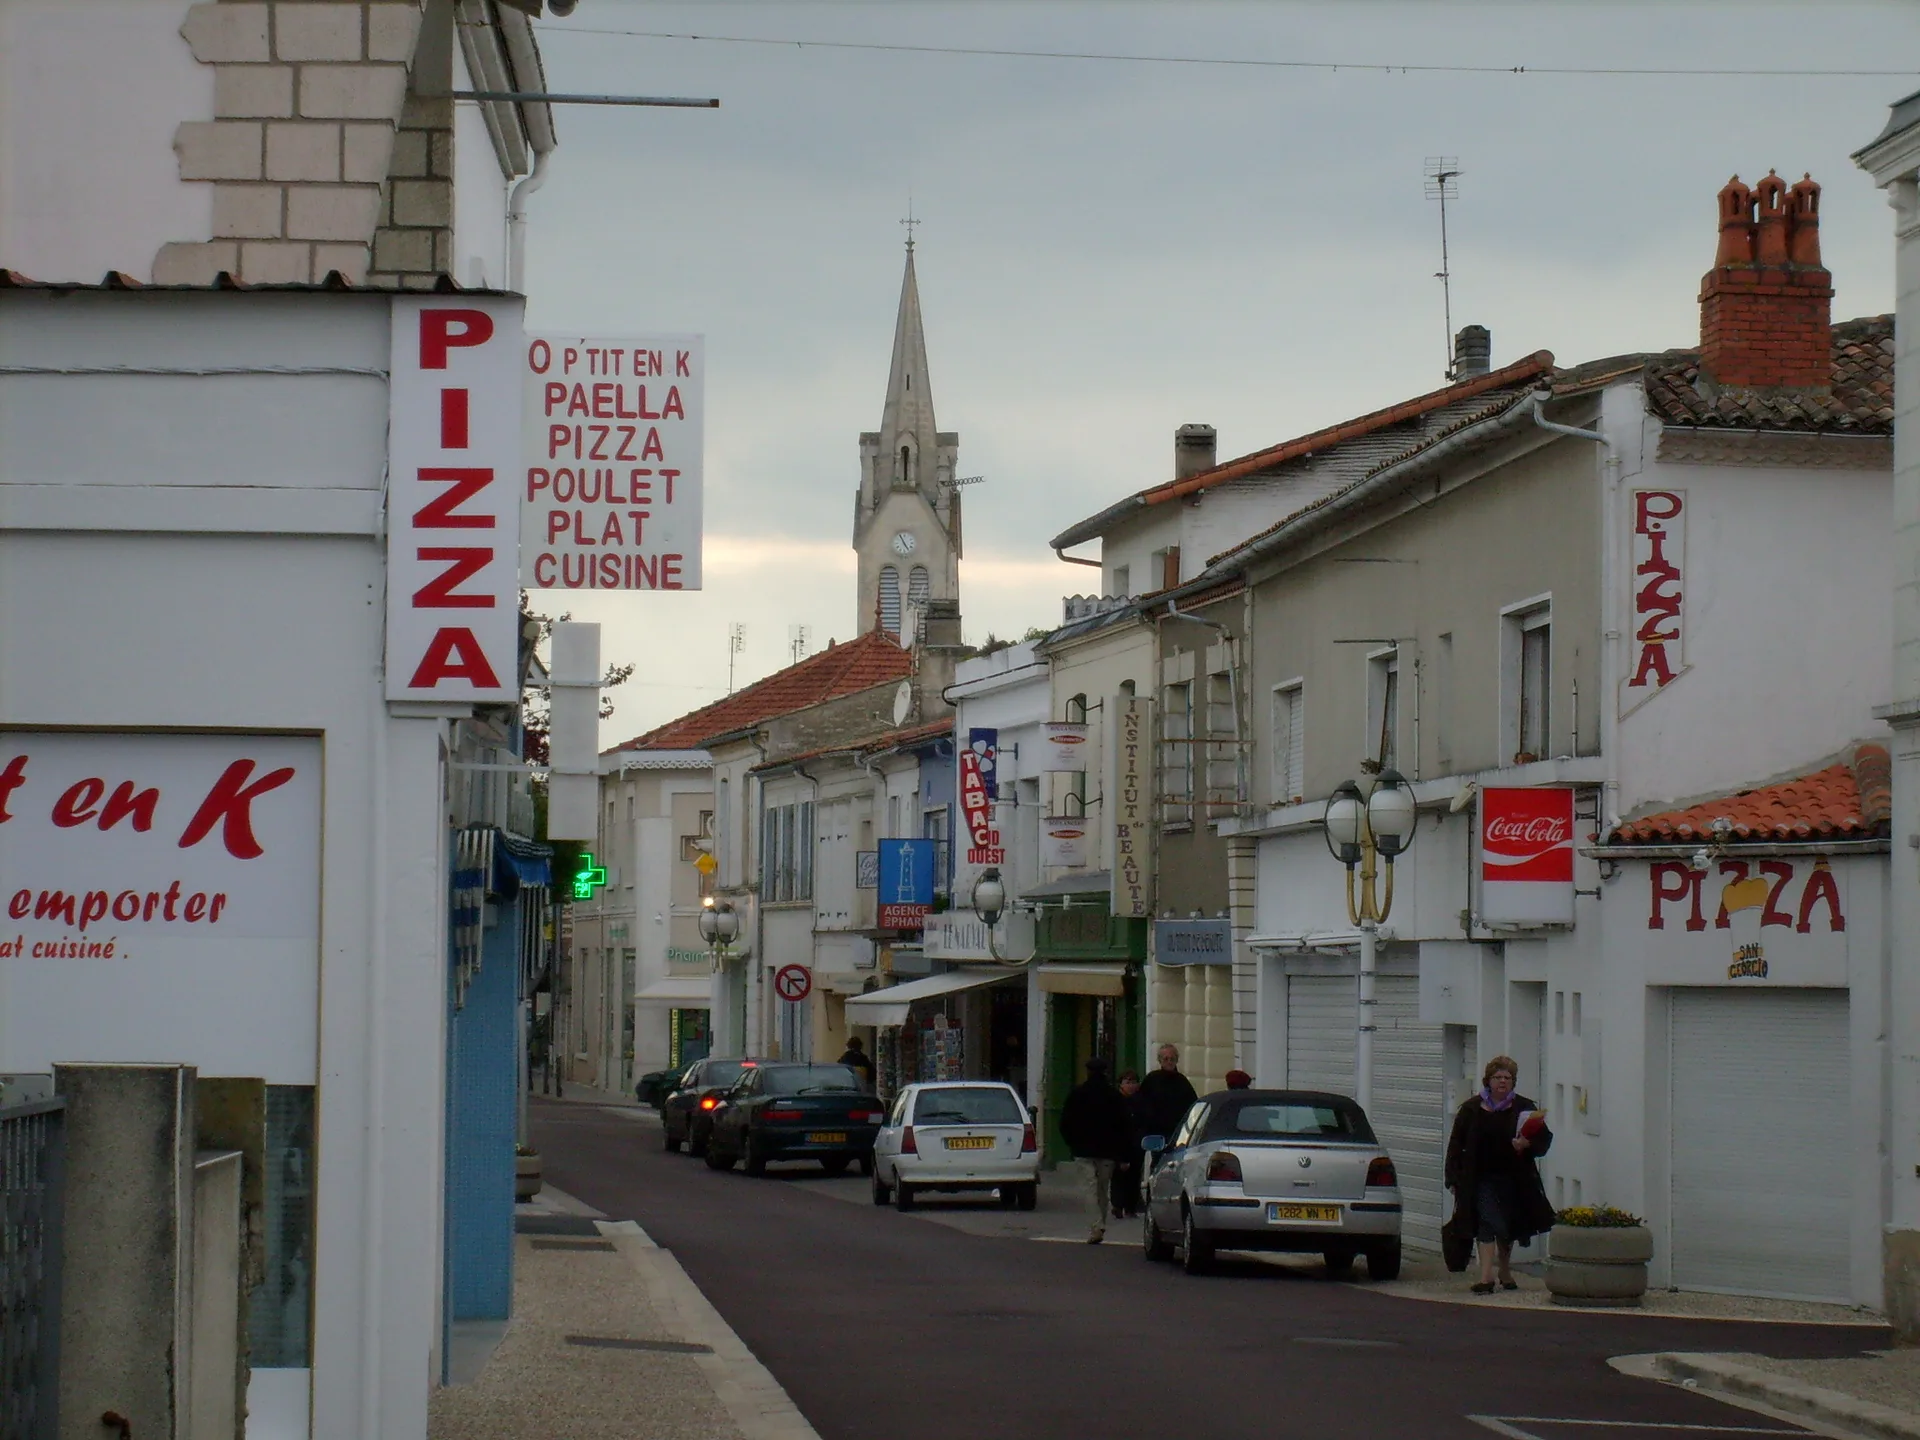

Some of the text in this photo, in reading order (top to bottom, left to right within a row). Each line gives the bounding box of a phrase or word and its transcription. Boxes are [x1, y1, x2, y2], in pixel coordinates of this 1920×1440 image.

[528, 339, 551, 374] O
[633, 349, 663, 377] EN
[676, 350, 690, 377] K
[545, 382, 685, 420] PAELLA
[549, 425, 664, 461] PIZZA
[407, 308, 502, 689] PIZZA
[527, 468, 681, 504] POULET
[548, 510, 651, 546] PLAT
[534, 553, 683, 590] CUISINE
[1629, 491, 1683, 687] PIZZA
[1124, 700, 1142, 818] INSTITUT
[51, 777, 160, 832] en
[178, 758, 295, 860] K
[962, 753, 989, 846] TABAC
[1132, 820, 1144, 829] de
[1486, 816, 1567, 843] Coca-Cola
[967, 848, 1005, 864] OUEST
[1117, 824, 1145, 915] BEAUTE
[8, 880, 227, 932] emporter
[884, 905, 928, 916] AGENCE
[1648, 857, 1846, 934] PIZZA
[891, 916, 924, 927] PHAR
[1740, 942, 1759, 960] SAN
[1278, 1207, 1302, 1219] 1282
[1323, 1208, 1336, 1220] 17
